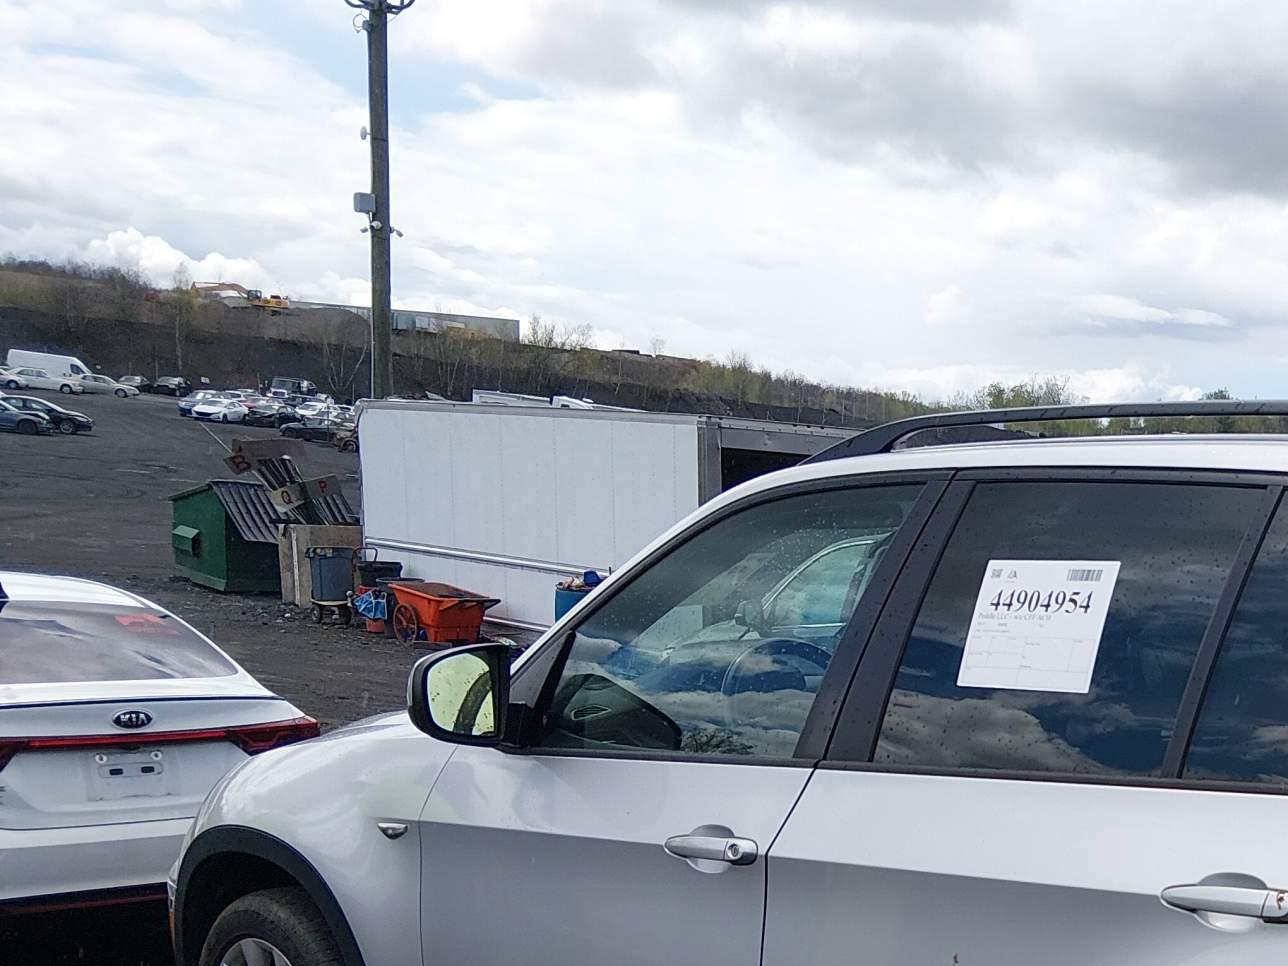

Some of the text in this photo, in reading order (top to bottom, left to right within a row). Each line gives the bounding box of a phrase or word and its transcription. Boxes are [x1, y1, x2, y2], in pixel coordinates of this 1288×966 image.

[232, 454, 252, 473] B
[281, 490, 294, 505] Q
[989, 588, 1094, 614] 44904954
[119, 712, 149, 726] KIA
